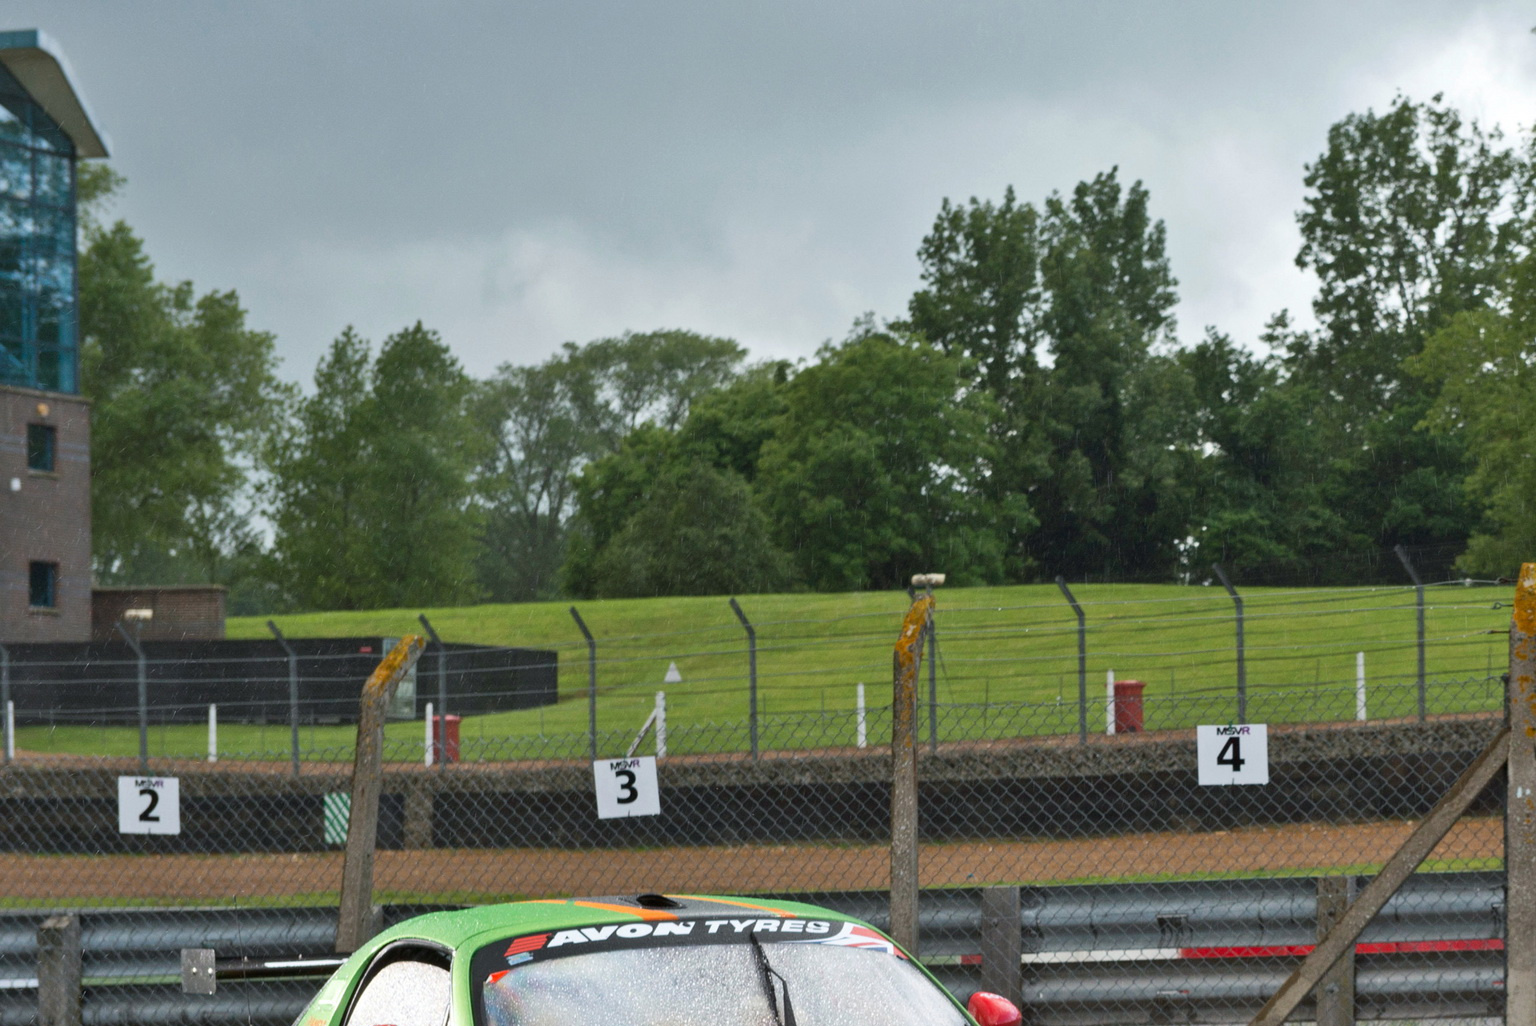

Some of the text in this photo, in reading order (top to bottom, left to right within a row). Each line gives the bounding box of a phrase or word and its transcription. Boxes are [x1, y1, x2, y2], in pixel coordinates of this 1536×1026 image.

[1217, 737, 1245, 771] 4
[615, 770, 638, 804] 3
[139, 789, 160, 821] 2
[547, 919, 830, 948] AVON TYRES
